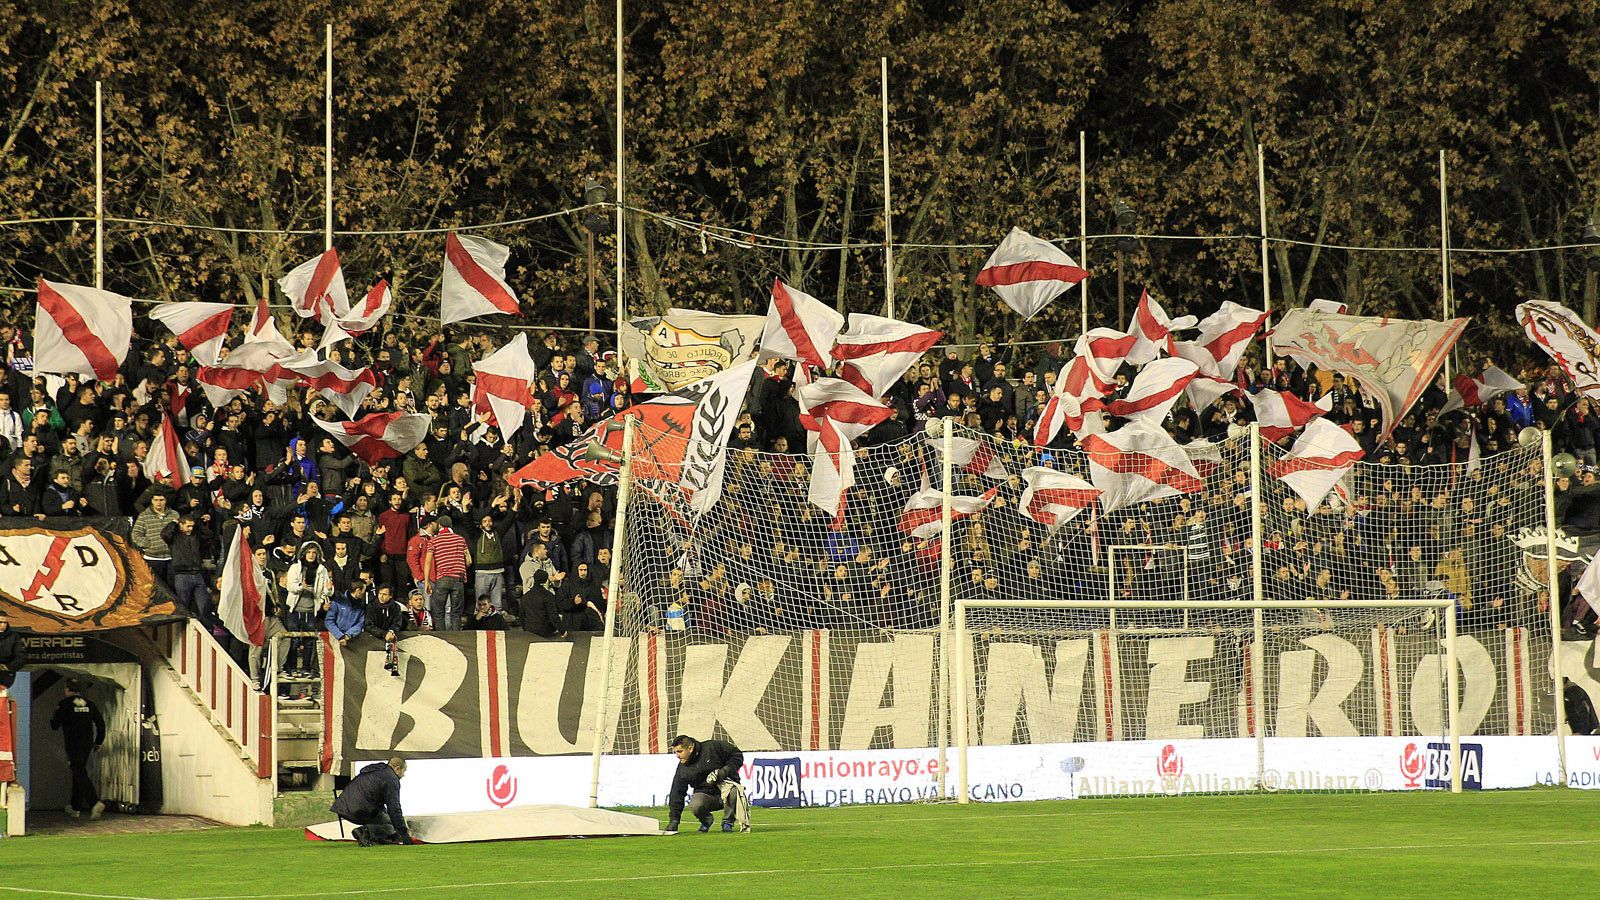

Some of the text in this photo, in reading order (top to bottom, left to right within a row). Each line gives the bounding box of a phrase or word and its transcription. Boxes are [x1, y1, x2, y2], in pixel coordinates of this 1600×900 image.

[658, 328, 667, 339] A
[73, 545, 99, 567] D
[51, 594, 84, 611] R
[41, 651, 85, 660] deportistas
[752, 764, 800, 800] BBVA
[1079, 777, 1156, 795] Allianz
[1183, 774, 1257, 791] Allianz
[1285, 771, 1360, 789] Allianz
[865, 787, 912, 804] RAYO
